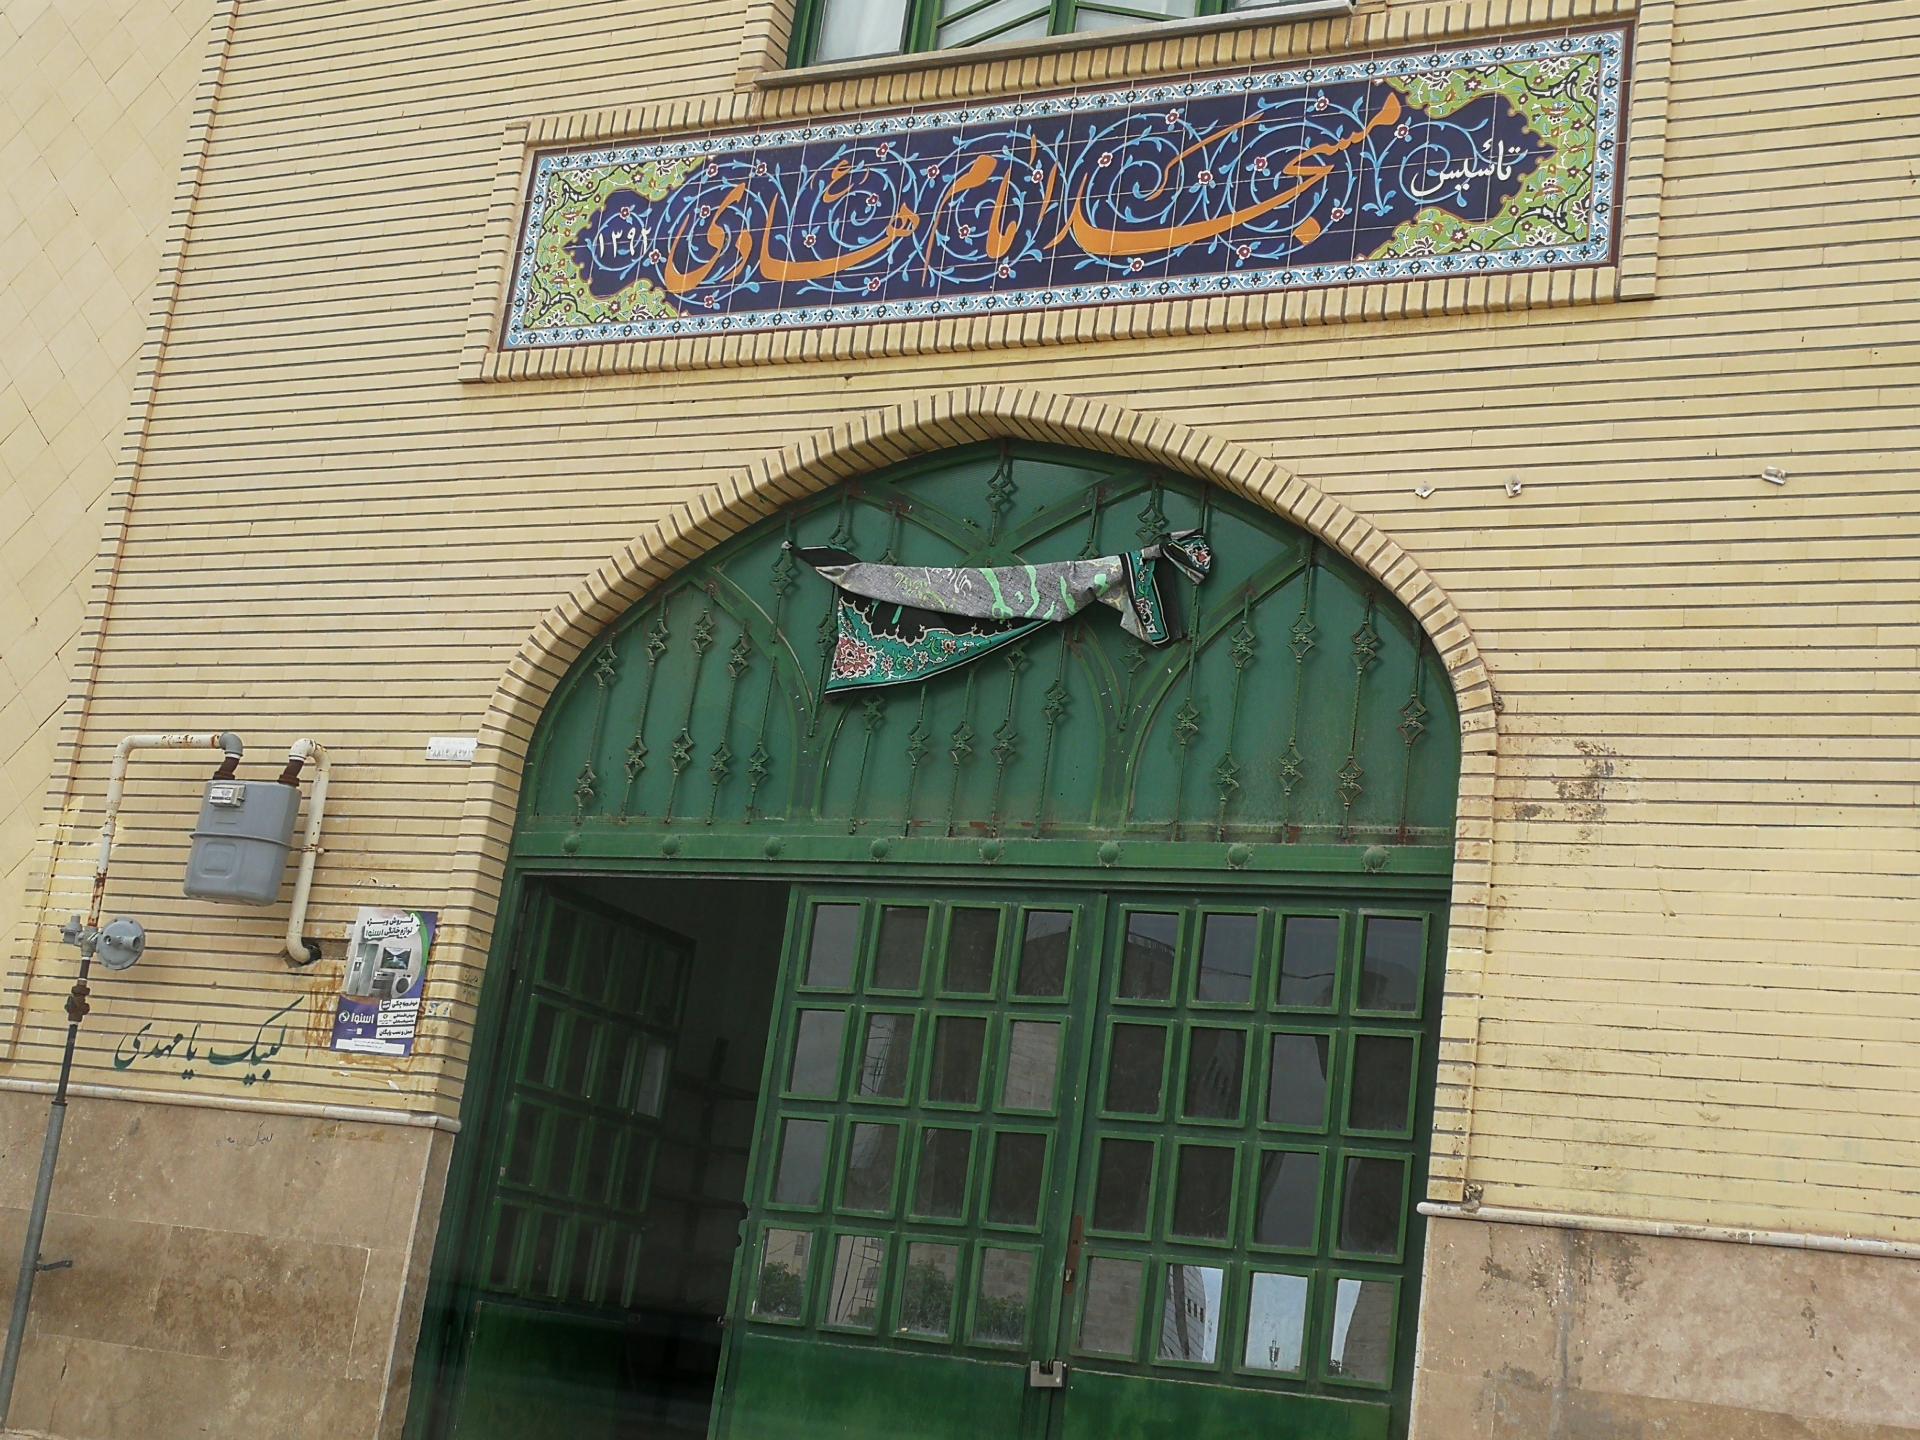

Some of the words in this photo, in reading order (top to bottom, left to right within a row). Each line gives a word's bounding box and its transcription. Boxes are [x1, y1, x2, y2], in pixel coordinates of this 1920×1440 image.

[1044, 91, 1402, 257] مسجد
[664, 182, 920, 293] هادی
[920, 134, 1057, 288] امام
[598, 226, 652, 259] ۱۳۹۲
[366, 917, 389, 927] ویژه
[390, 914, 414, 926] فروش
[208, 995, 305, 1086] لبیک
[351, 1011, 375, 1024] اسنوا
[114, 1022, 184, 1072] مهدی
[181, 1023, 202, 1080] یا
